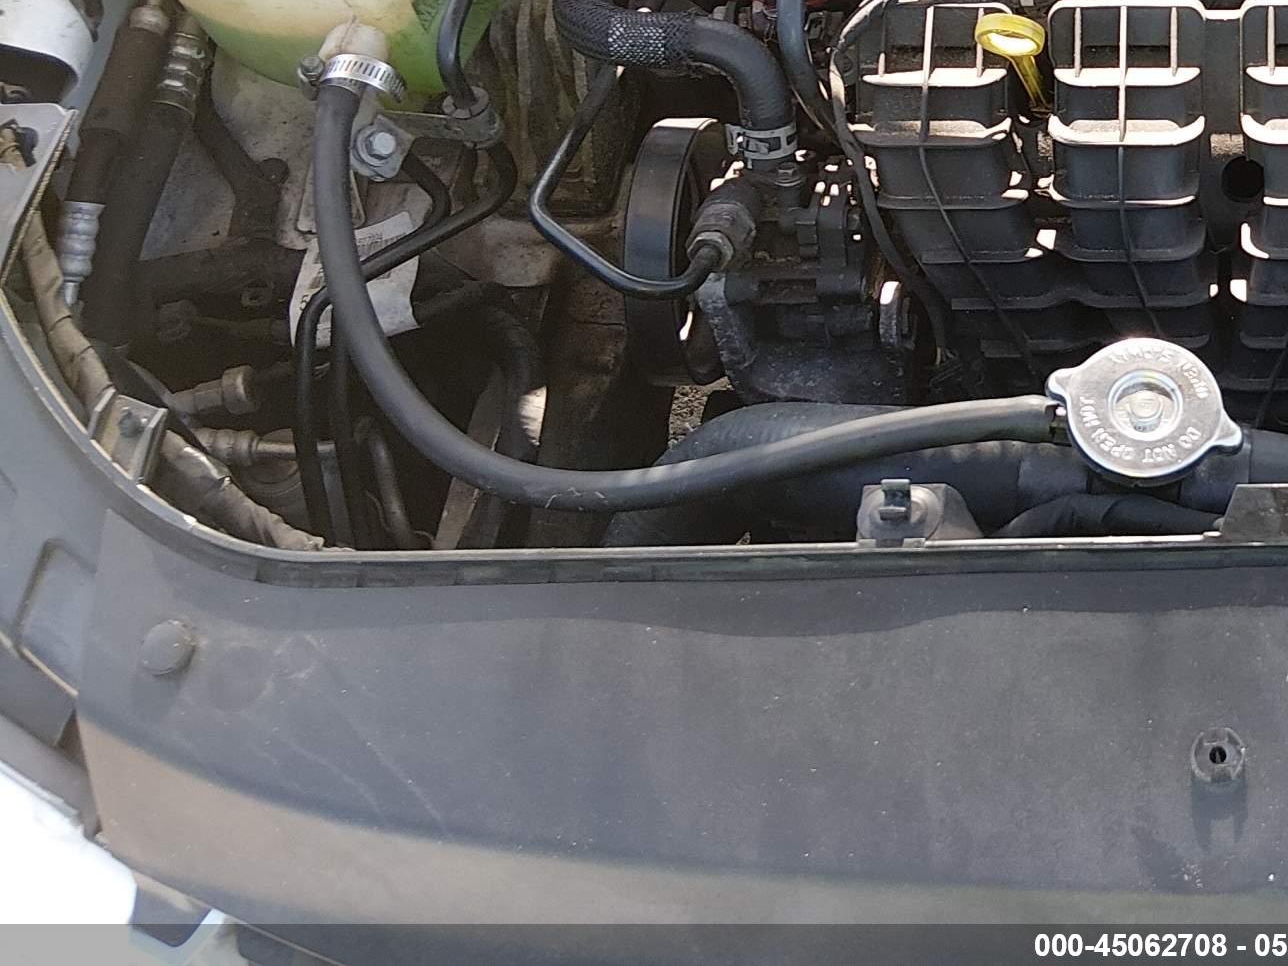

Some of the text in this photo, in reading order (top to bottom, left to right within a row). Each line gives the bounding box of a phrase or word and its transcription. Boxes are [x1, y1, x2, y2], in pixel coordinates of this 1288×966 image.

[1091, 427, 1136, 460] OPEN
[1178, 426, 1202, 449] DO
[1142, 443, 1178, 463] NOT
